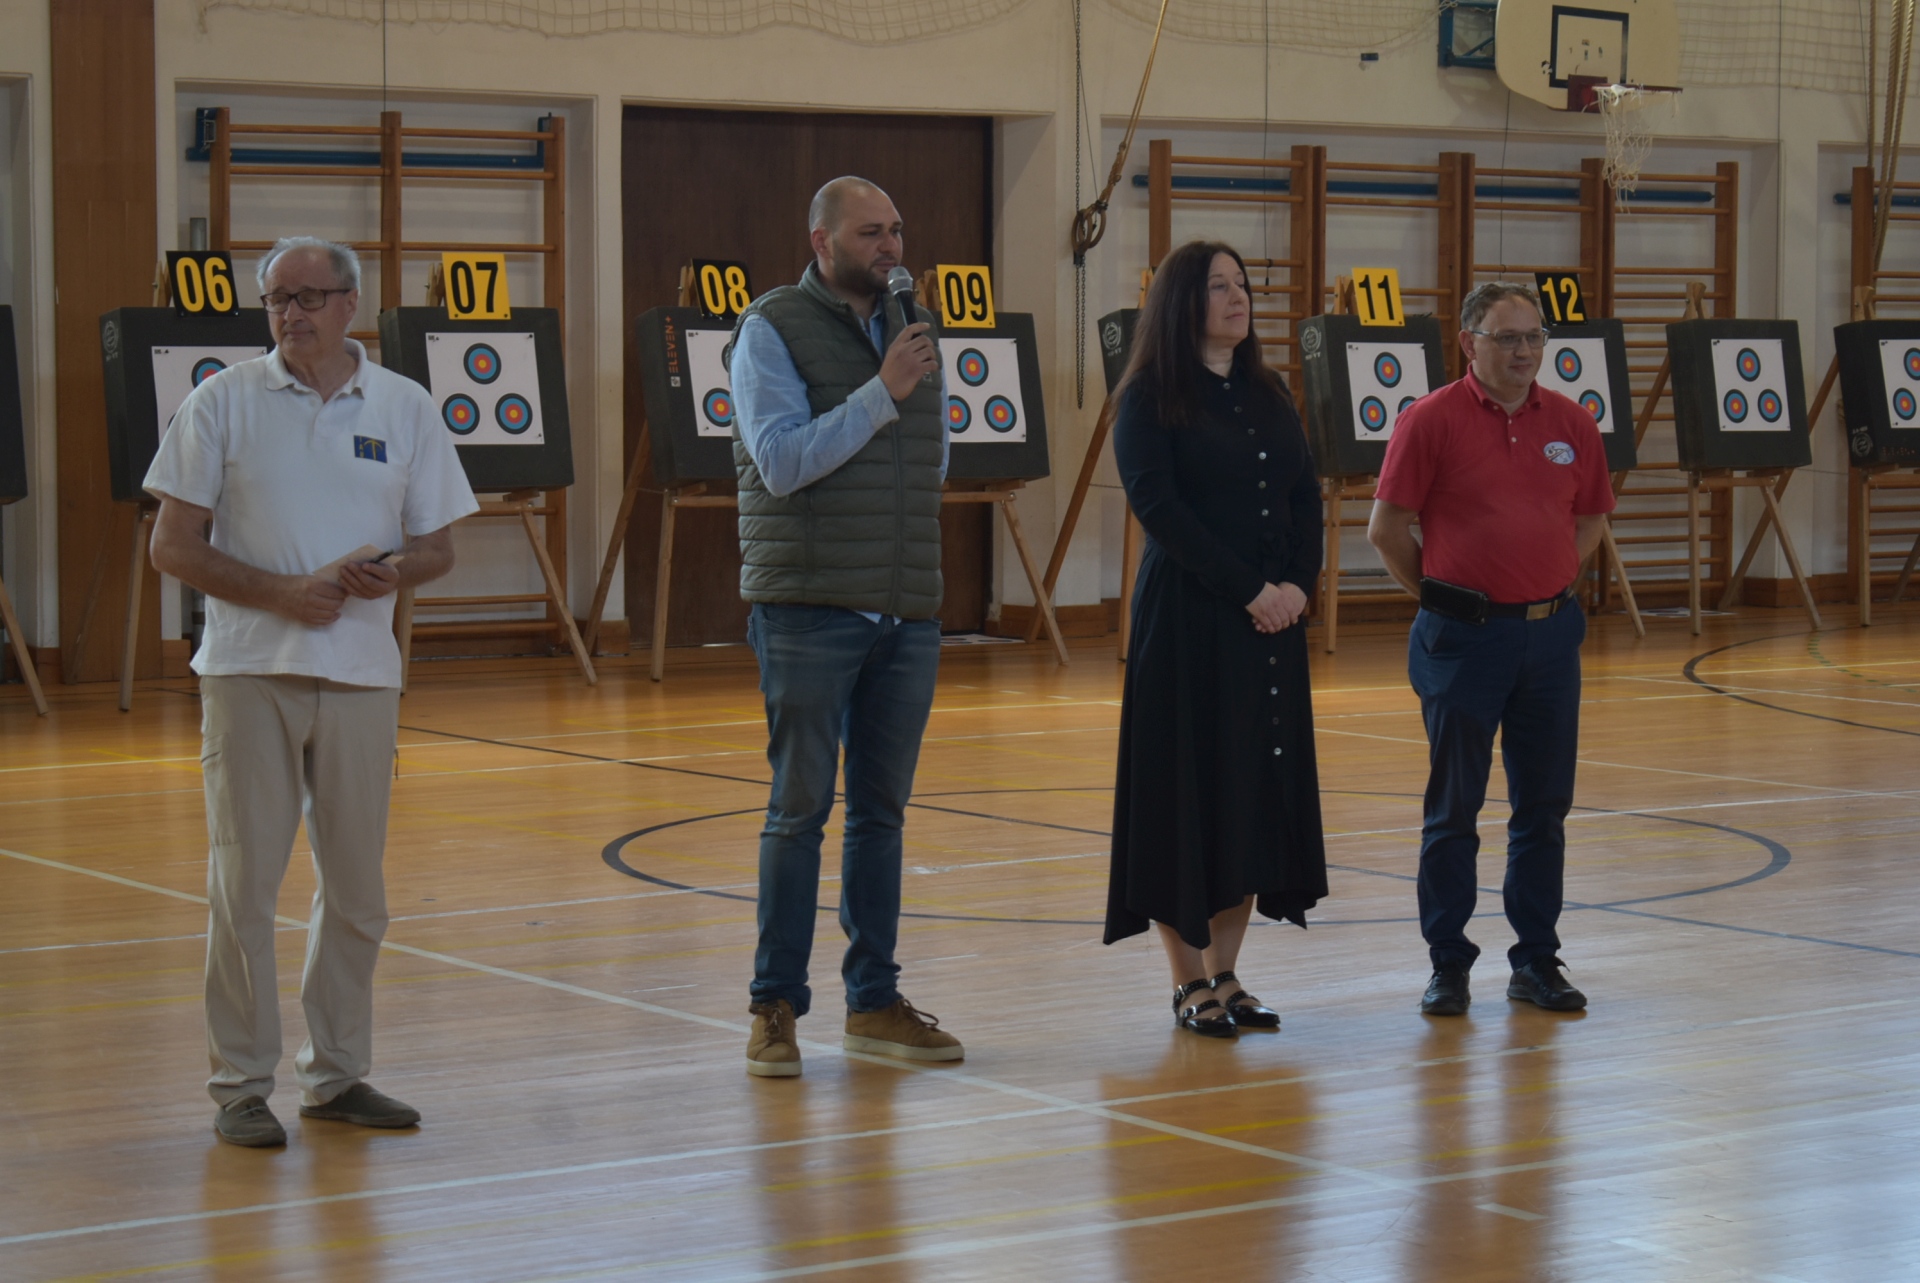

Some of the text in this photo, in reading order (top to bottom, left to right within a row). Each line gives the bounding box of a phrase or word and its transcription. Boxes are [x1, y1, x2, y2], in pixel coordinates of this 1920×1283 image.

[176, 257, 232, 313] 06
[450, 260, 500, 315] 07
[700, 264, 751, 315] 08
[944, 271, 989, 322] 09
[1357, 274, 1395, 321] 11
[1541, 276, 1584, 322] 12
